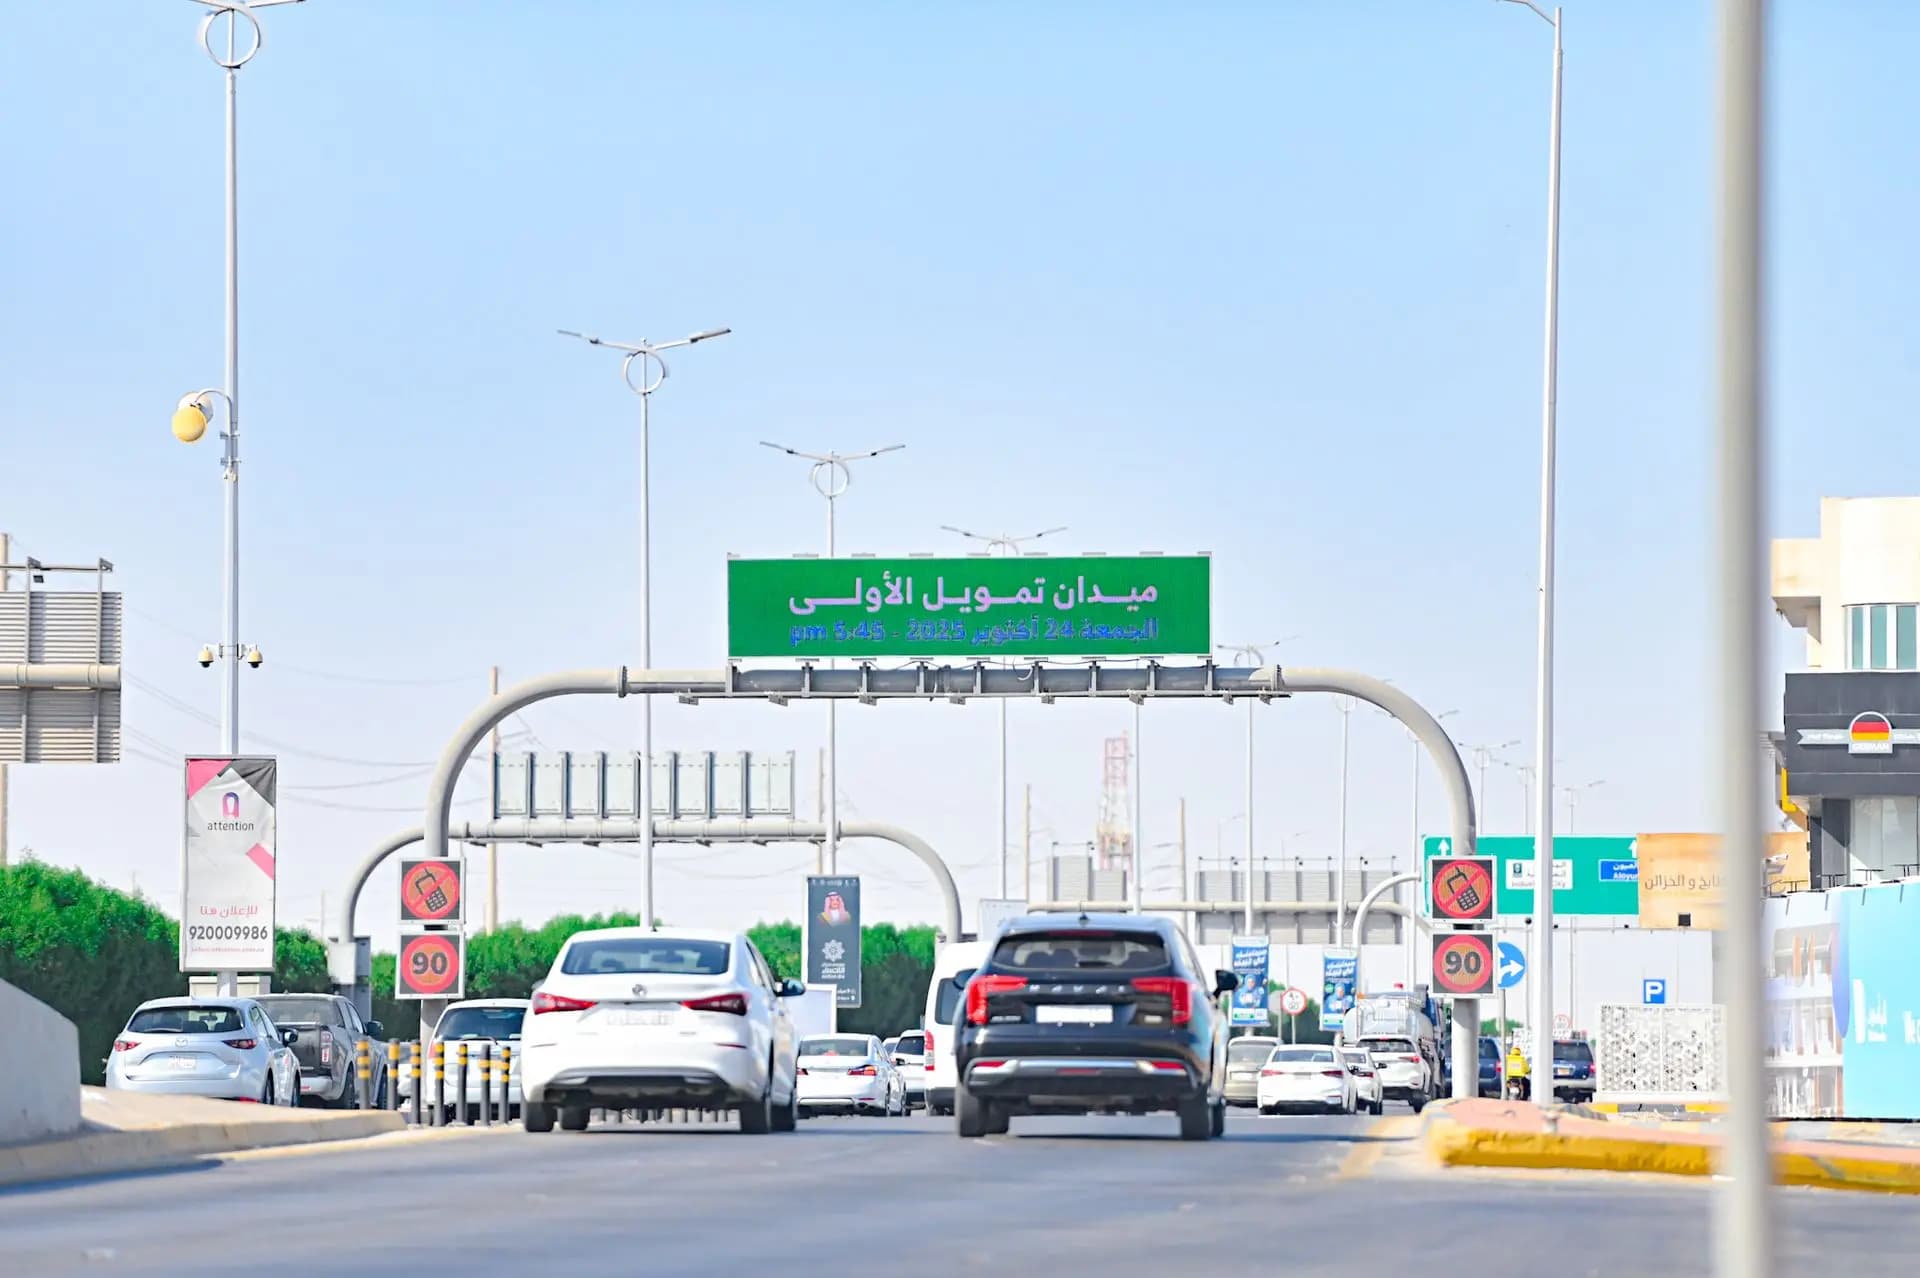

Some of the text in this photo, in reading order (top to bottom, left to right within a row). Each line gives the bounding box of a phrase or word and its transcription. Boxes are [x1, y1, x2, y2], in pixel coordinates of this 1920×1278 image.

[789, 570, 1158, 615] ميدان تمويل الأولى
[907, 619, 966, 641] 2025
[1045, 617, 1074, 640] 24
[1079, 617, 1158, 643] الجمعة
[207, 821, 254, 831] attention
[200, 905, 217, 916] هنا
[189, 926, 268, 940] 920009986
[412, 951, 448, 975] 90
[1445, 951, 1481, 974] 90
[1646, 981, 1663, 1002] P
